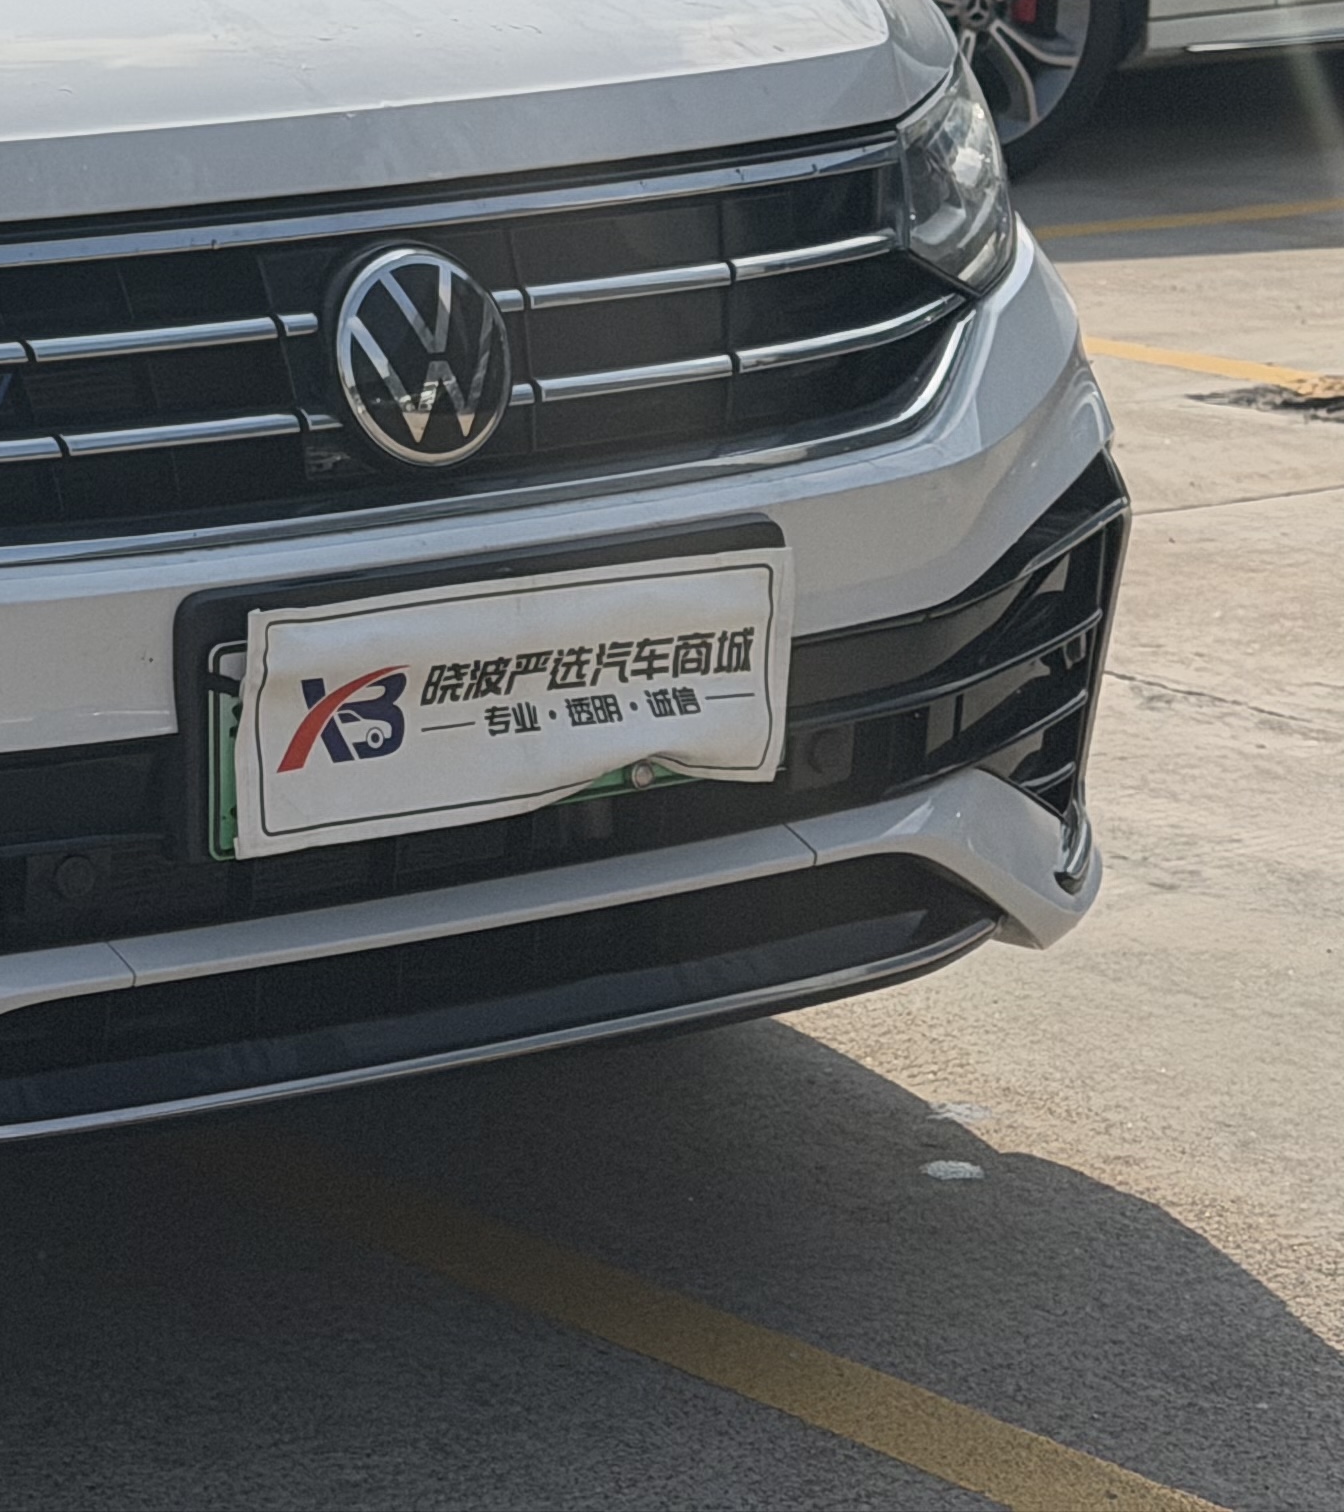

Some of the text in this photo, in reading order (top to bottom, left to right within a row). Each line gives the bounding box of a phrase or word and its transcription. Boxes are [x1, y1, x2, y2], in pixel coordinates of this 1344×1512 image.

[419, 626, 755, 707] 晓波严选汽车商城
